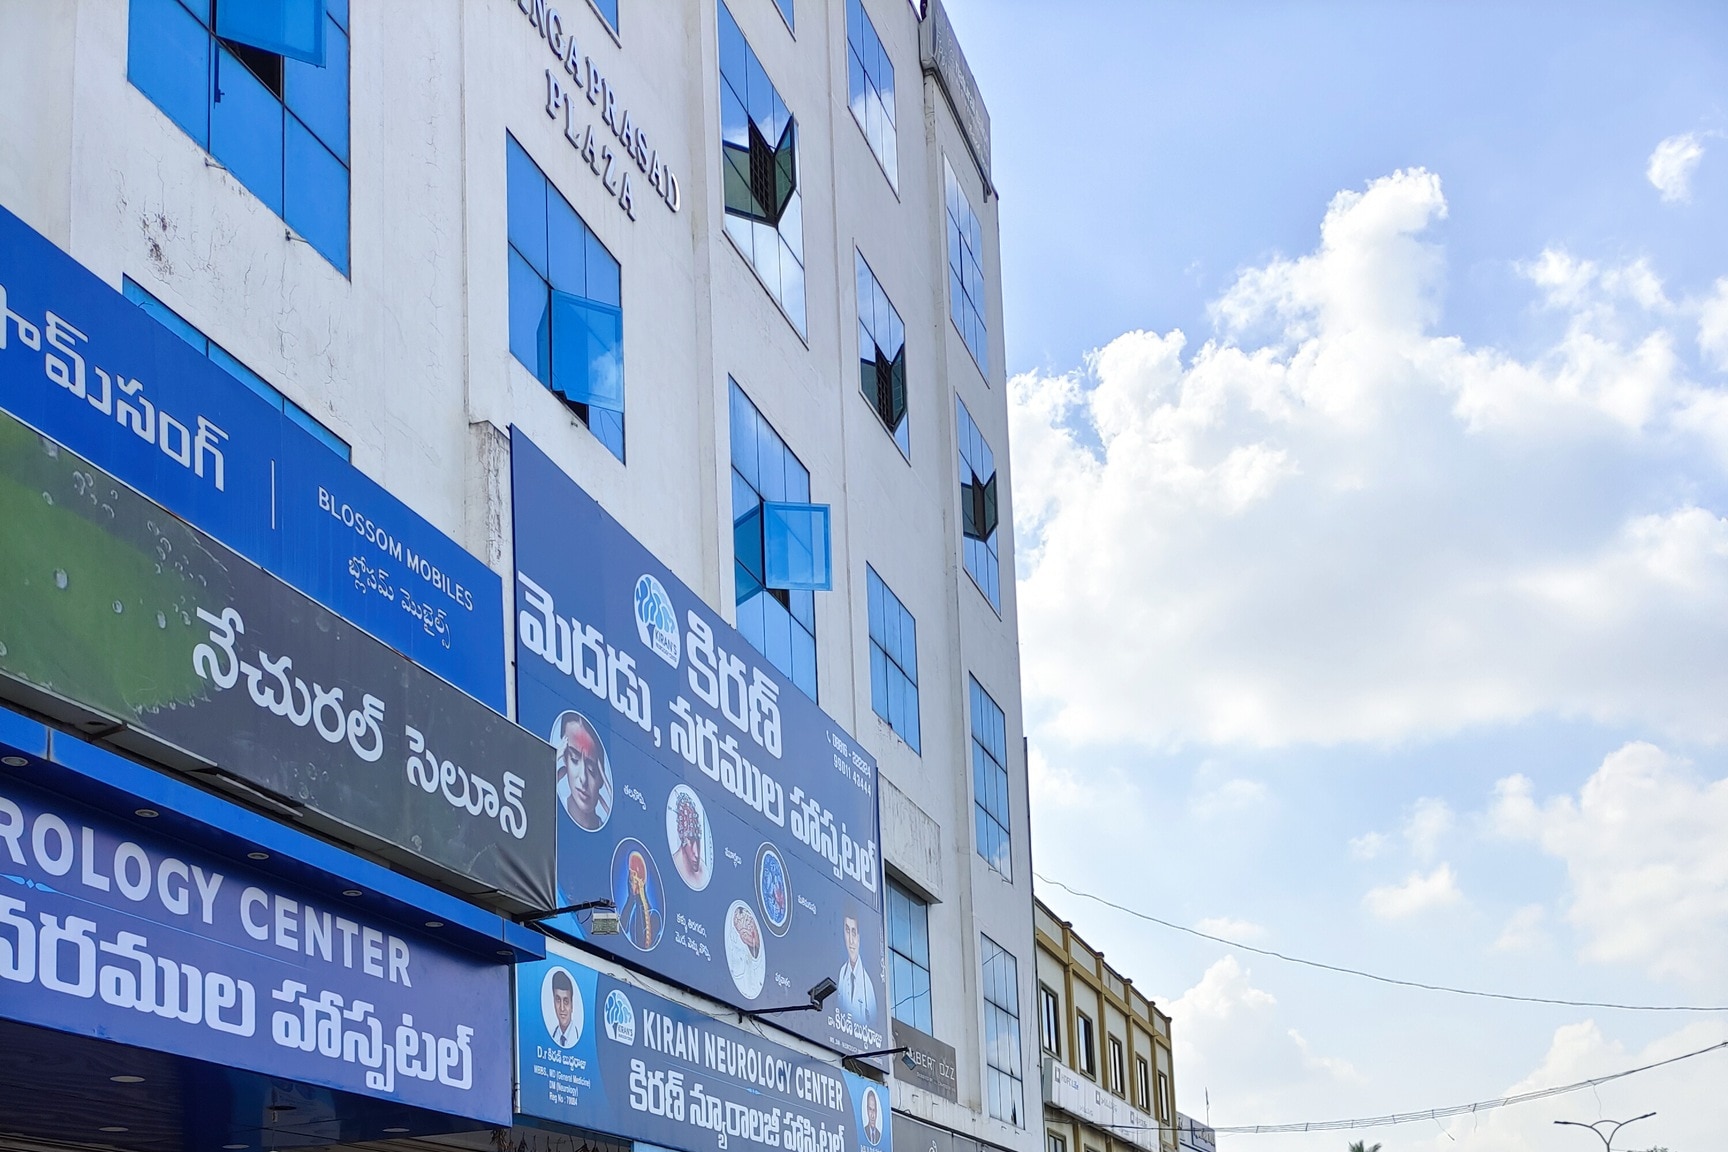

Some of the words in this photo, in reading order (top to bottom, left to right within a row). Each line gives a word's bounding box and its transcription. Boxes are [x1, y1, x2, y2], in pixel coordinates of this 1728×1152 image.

[545, 68, 636, 222] PLAZA
[318, 485, 402, 562] BLOSSOM
[407, 548, 474, 612] MOBILES
[192, 606, 385, 763] నేచురల్
[405, 724, 529, 841] సెలూన్
[686, 608, 783, 760] కిరణ్
[669, 695, 785, 828] నరముల
[240, 886, 413, 988] CENTER
[629, 1058, 685, 1123] కిరణ్
[643, 1008, 699, 1065] KIRAN
[704, 1031, 793, 1094] NEUROLOGY
[795, 1066, 844, 1113] CENTER
